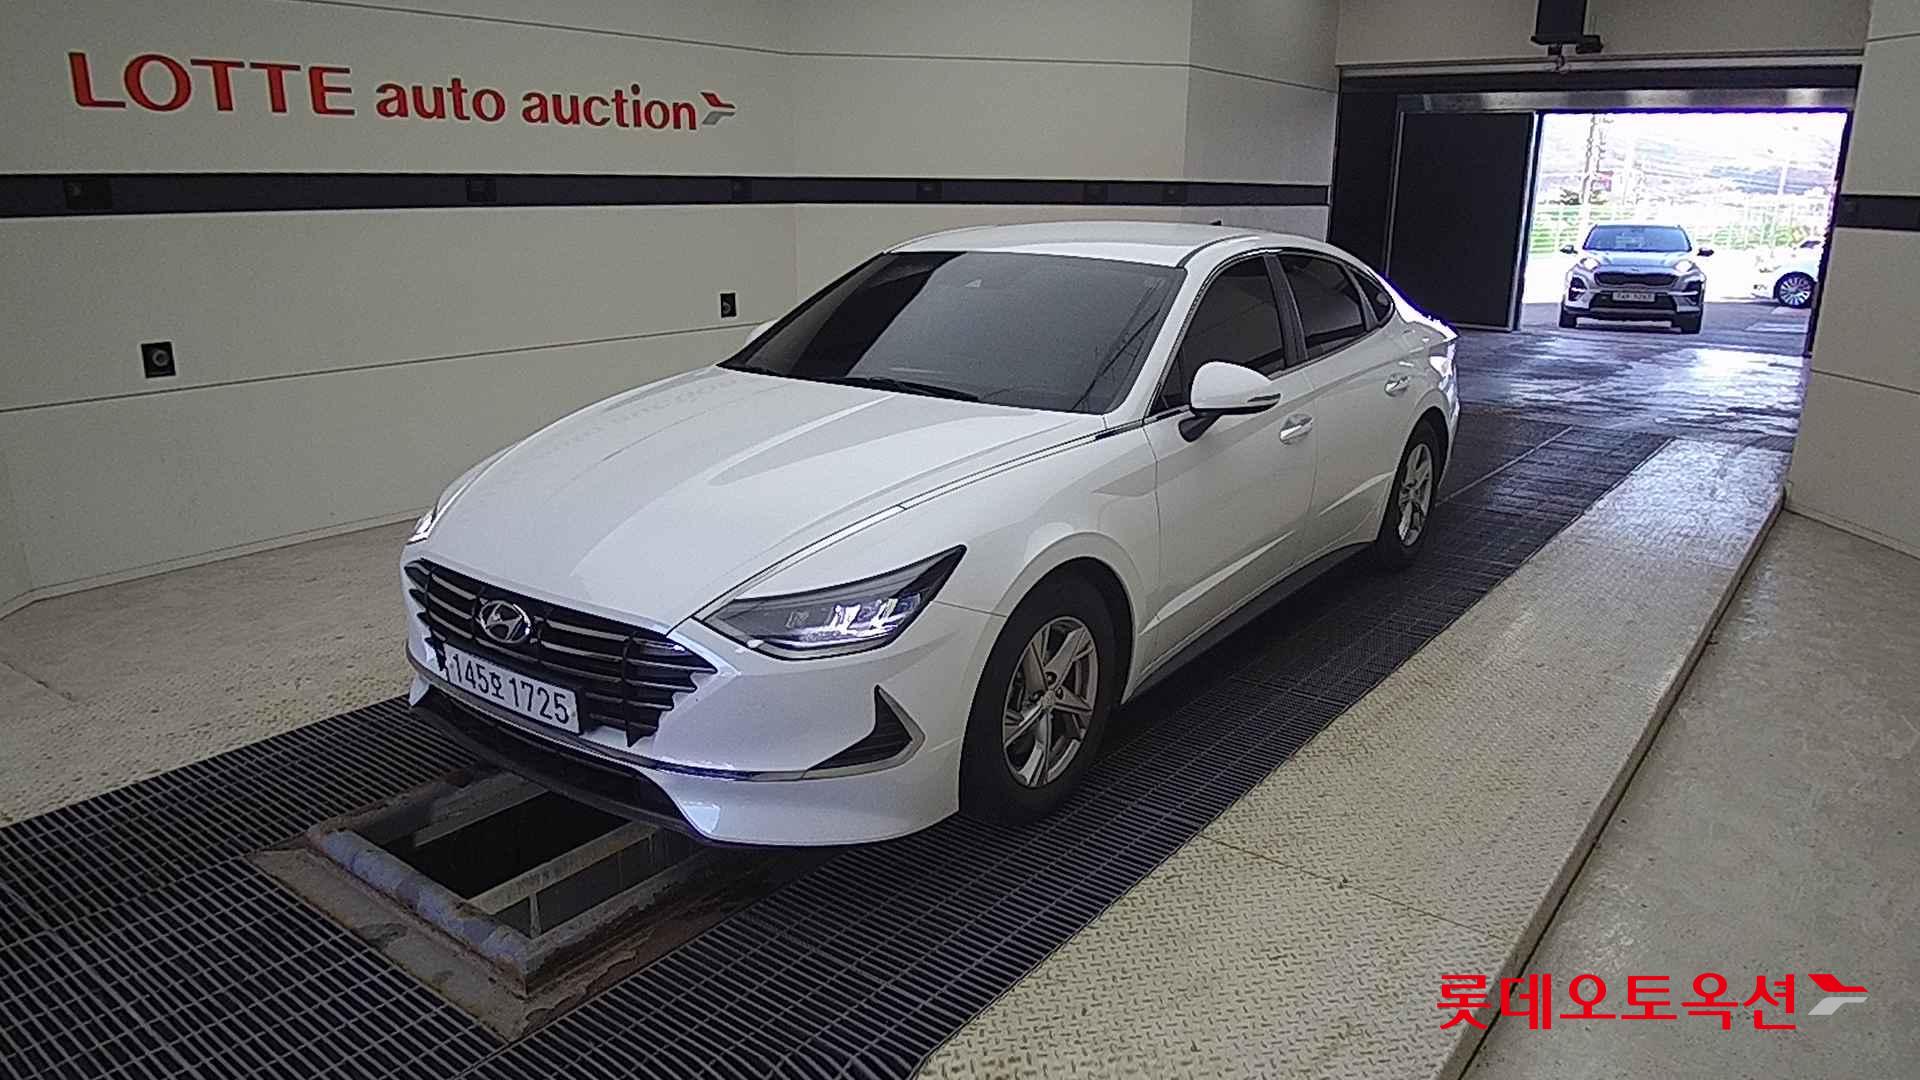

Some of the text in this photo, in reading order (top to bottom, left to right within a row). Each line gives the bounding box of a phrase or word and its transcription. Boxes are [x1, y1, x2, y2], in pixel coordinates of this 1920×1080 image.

[69, 52, 697, 130] LOTTE auto auction
[509, 677, 570, 724] 1725
